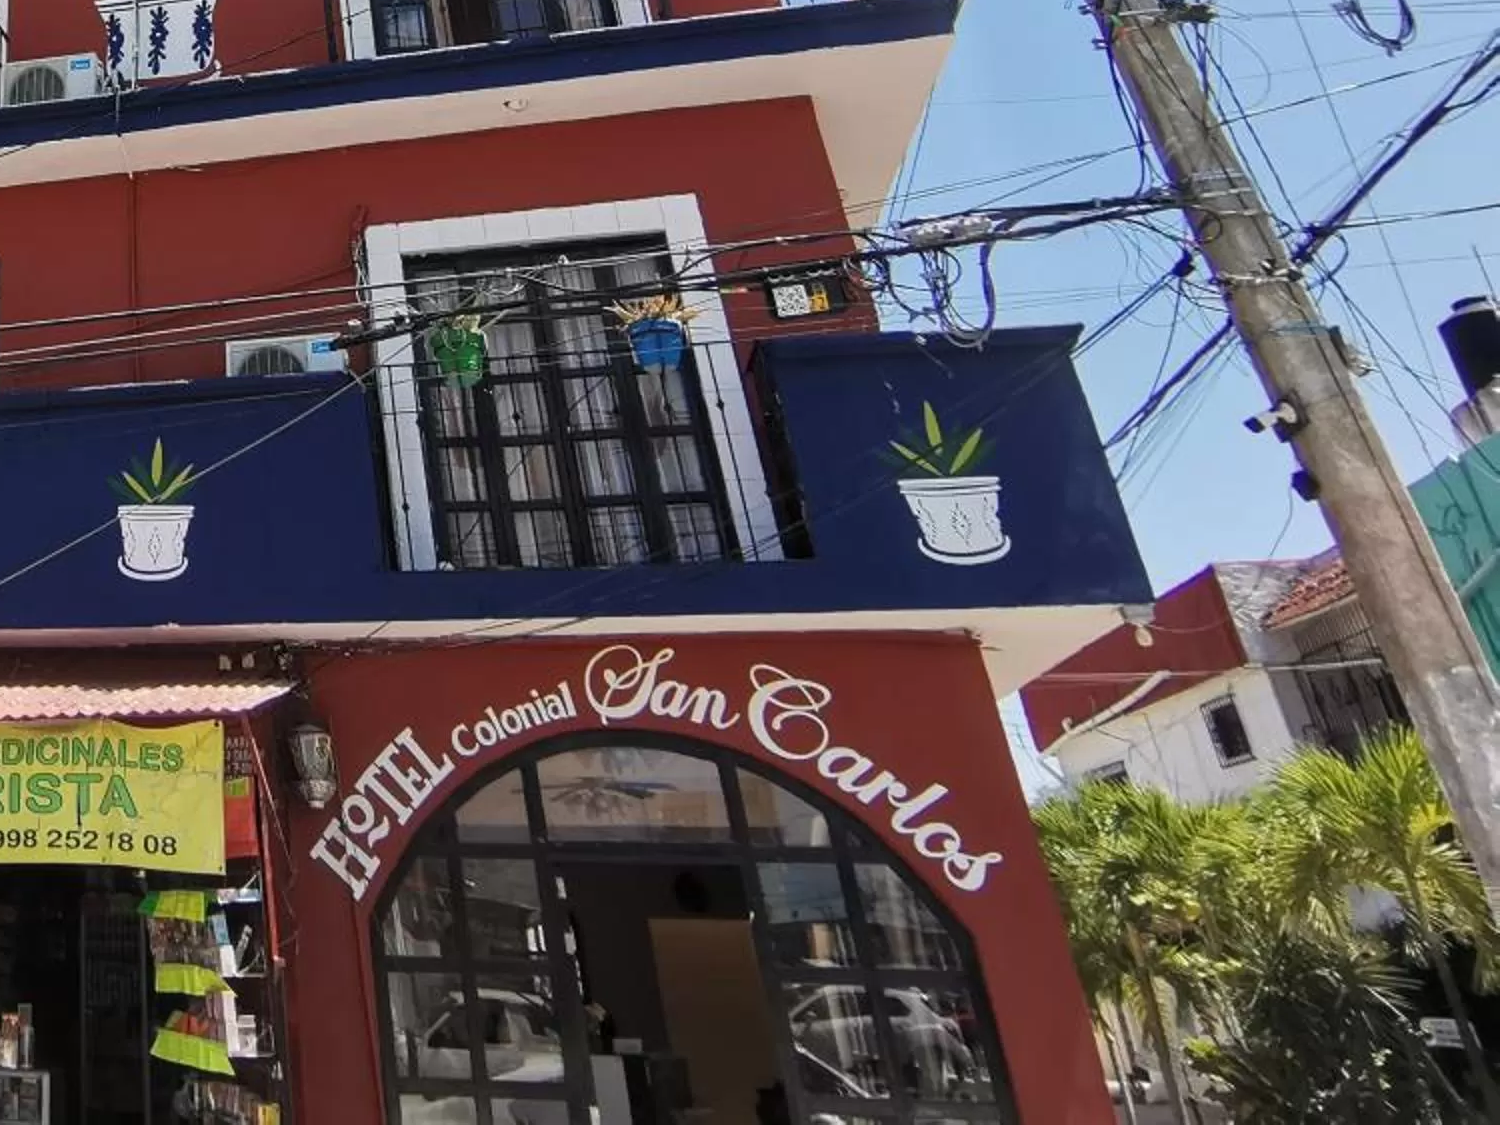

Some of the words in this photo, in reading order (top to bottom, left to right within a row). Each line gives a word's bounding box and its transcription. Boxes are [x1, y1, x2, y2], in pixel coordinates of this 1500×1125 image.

[47, 830, 99, 850] 252
[106, 832, 134, 852] 18
[143, 836, 178, 856] 08
[309, 727, 455, 901] HOTEL
[451, 680, 577, 756] Colonial
[584, 645, 740, 729] San
[748, 664, 1002, 891] Carlos
